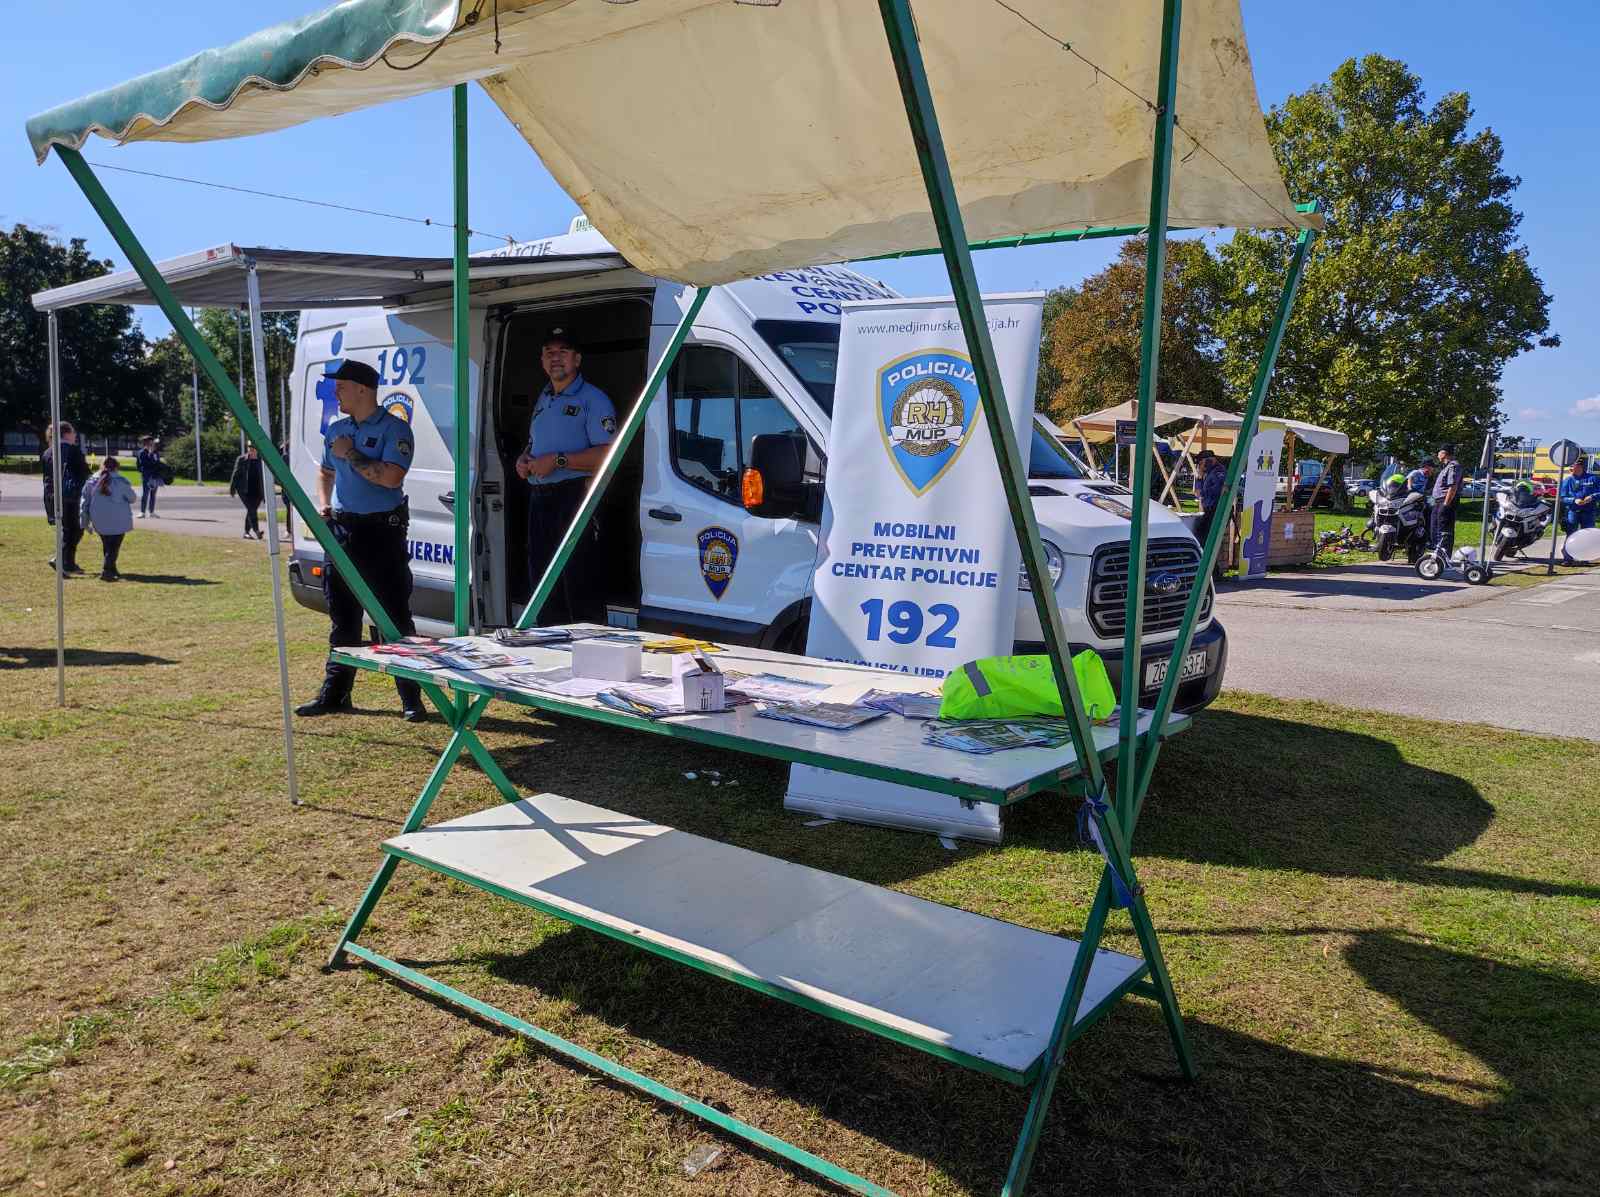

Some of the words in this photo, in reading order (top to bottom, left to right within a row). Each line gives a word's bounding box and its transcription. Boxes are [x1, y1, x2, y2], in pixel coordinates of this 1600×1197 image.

[378, 346, 426, 386] 192
[888, 361, 977, 386] POLICIJA
[907, 401, 948, 425] RH
[905, 428, 946, 440] MUP
[699, 531, 737, 544] POLICIJA
[873, 522, 956, 540] MOBILNI
[851, 542, 980, 564] PREVENTIVNI
[831, 562, 906, 581] CENTAR
[911, 567, 998, 588] POLICIJE
[860, 598, 960, 649] 192
[1152, 662, 1168, 684] ZG
